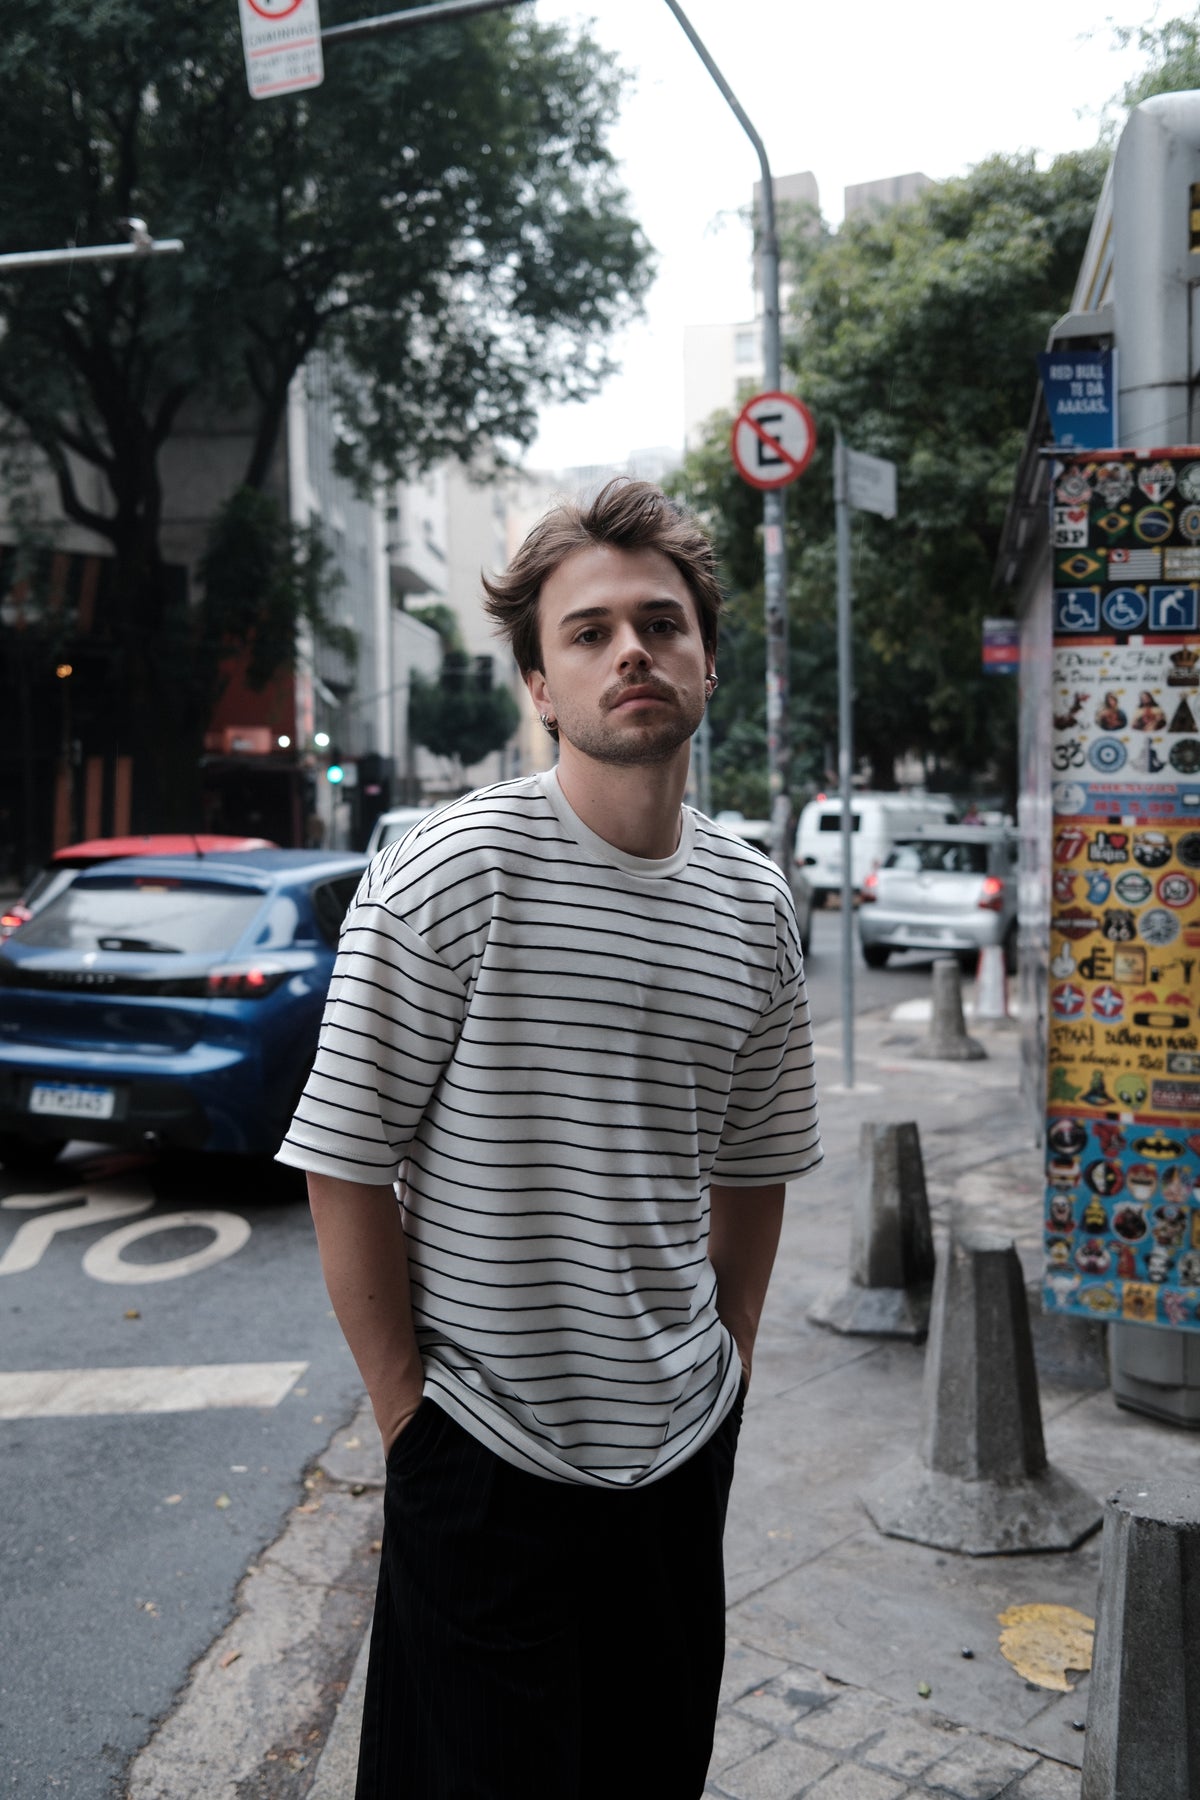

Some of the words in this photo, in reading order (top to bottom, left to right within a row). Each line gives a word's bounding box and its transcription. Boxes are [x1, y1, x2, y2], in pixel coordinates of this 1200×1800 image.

[1049, 364, 1074, 380] RED
[1075, 364, 1104, 380] BULL
[1070, 381, 1083, 397] TE
[1056, 530, 1085, 544] SP
